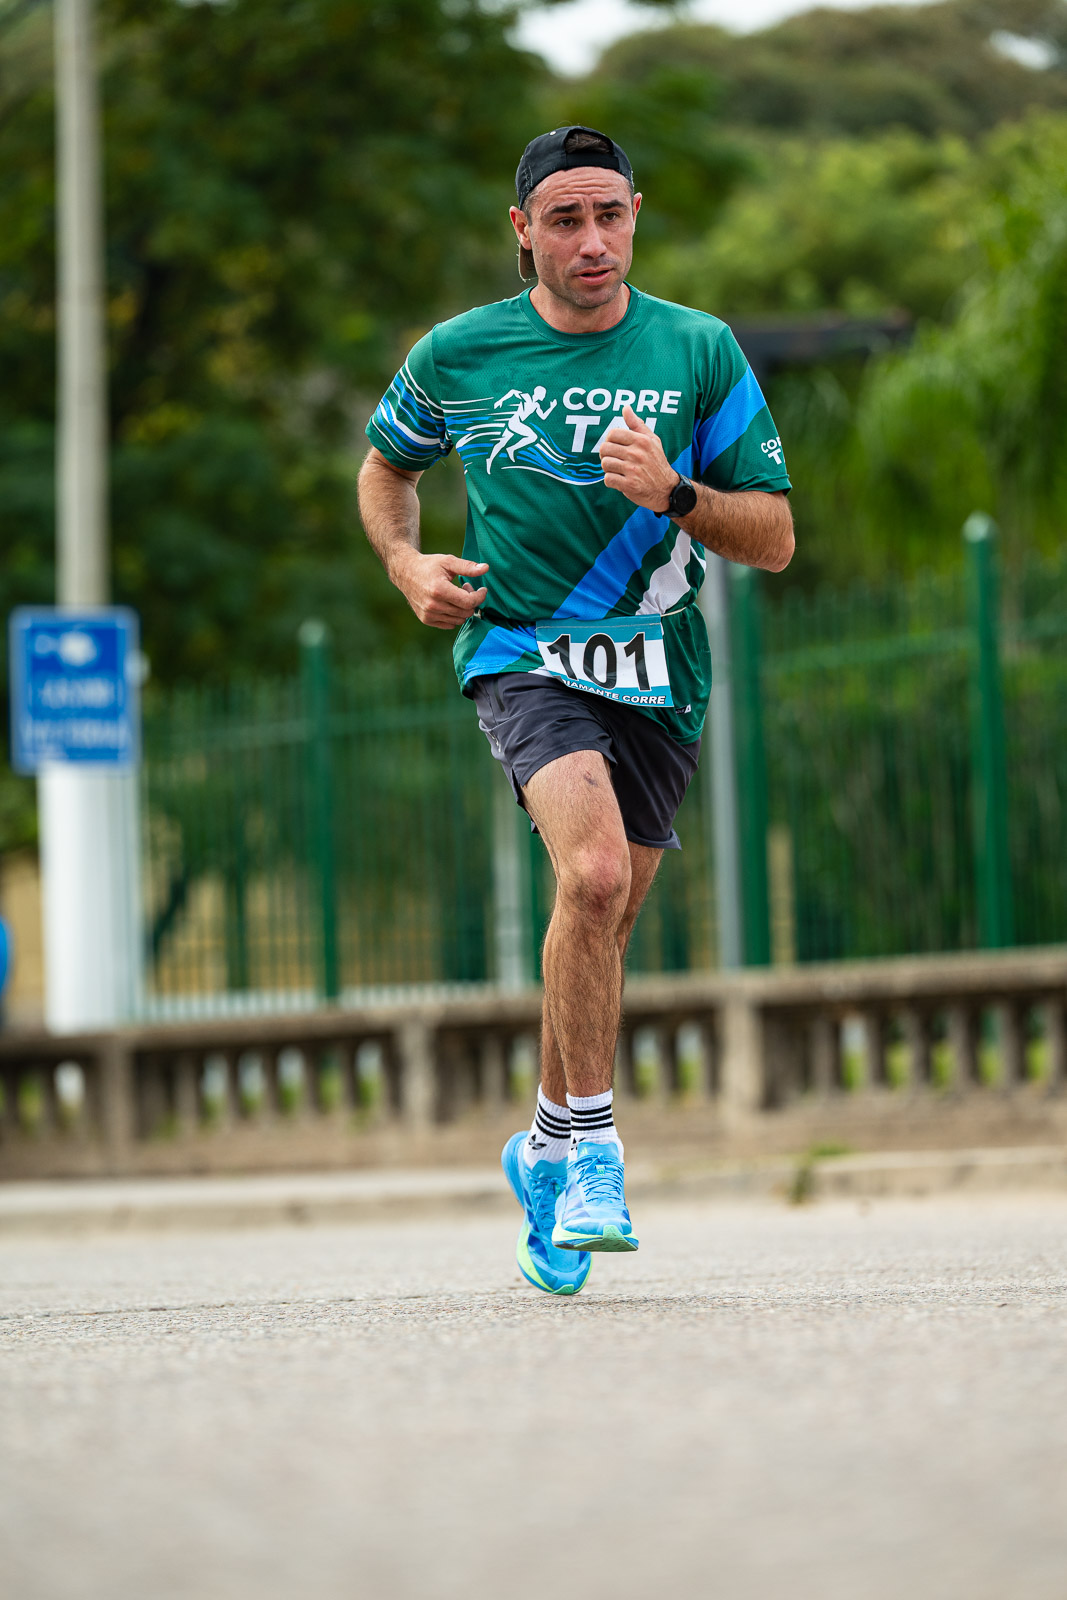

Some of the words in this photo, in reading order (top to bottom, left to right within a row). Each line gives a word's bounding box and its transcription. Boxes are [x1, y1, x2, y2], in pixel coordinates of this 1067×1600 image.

[562, 387, 682, 414] CORRE
[547, 632, 652, 691] 101
[622, 695, 666, 705] CORRE
